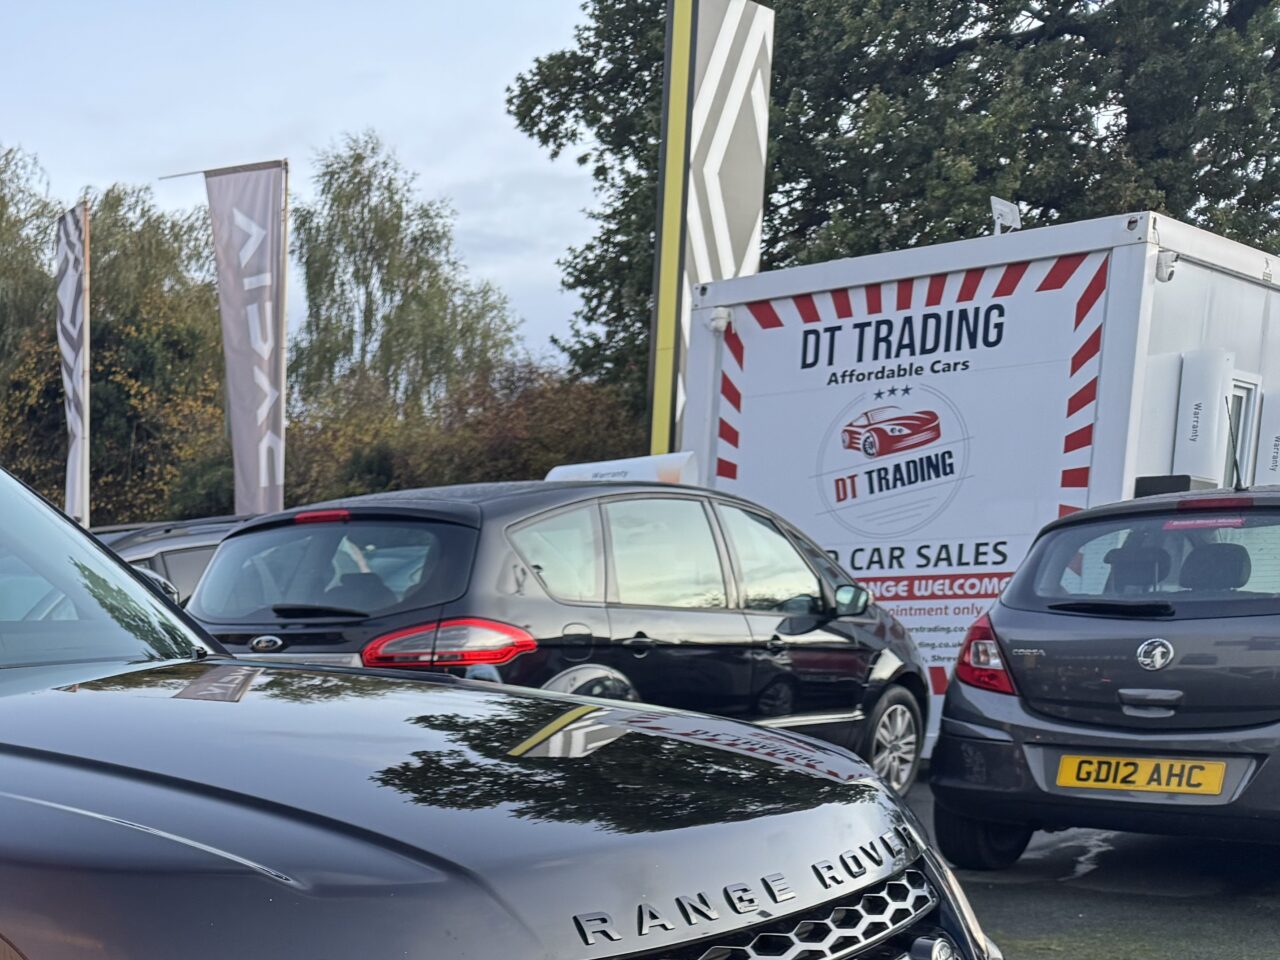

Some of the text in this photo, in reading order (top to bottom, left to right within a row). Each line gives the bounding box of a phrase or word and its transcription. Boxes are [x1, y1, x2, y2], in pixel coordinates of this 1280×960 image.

[801, 304, 1005, 369] DT TRADING
[827, 360, 969, 386] Affordable Cars
[1189, 402, 1202, 442] Warranty
[592, 470, 629, 479] Warranty
[834, 450, 954, 503] DT TRADING
[851, 541, 1007, 570] CAR SALES
[887, 603, 983, 617] ointment only
[1075, 760, 1205, 788] GD12 AHC
[572, 825, 916, 945] RANGE ROVER
